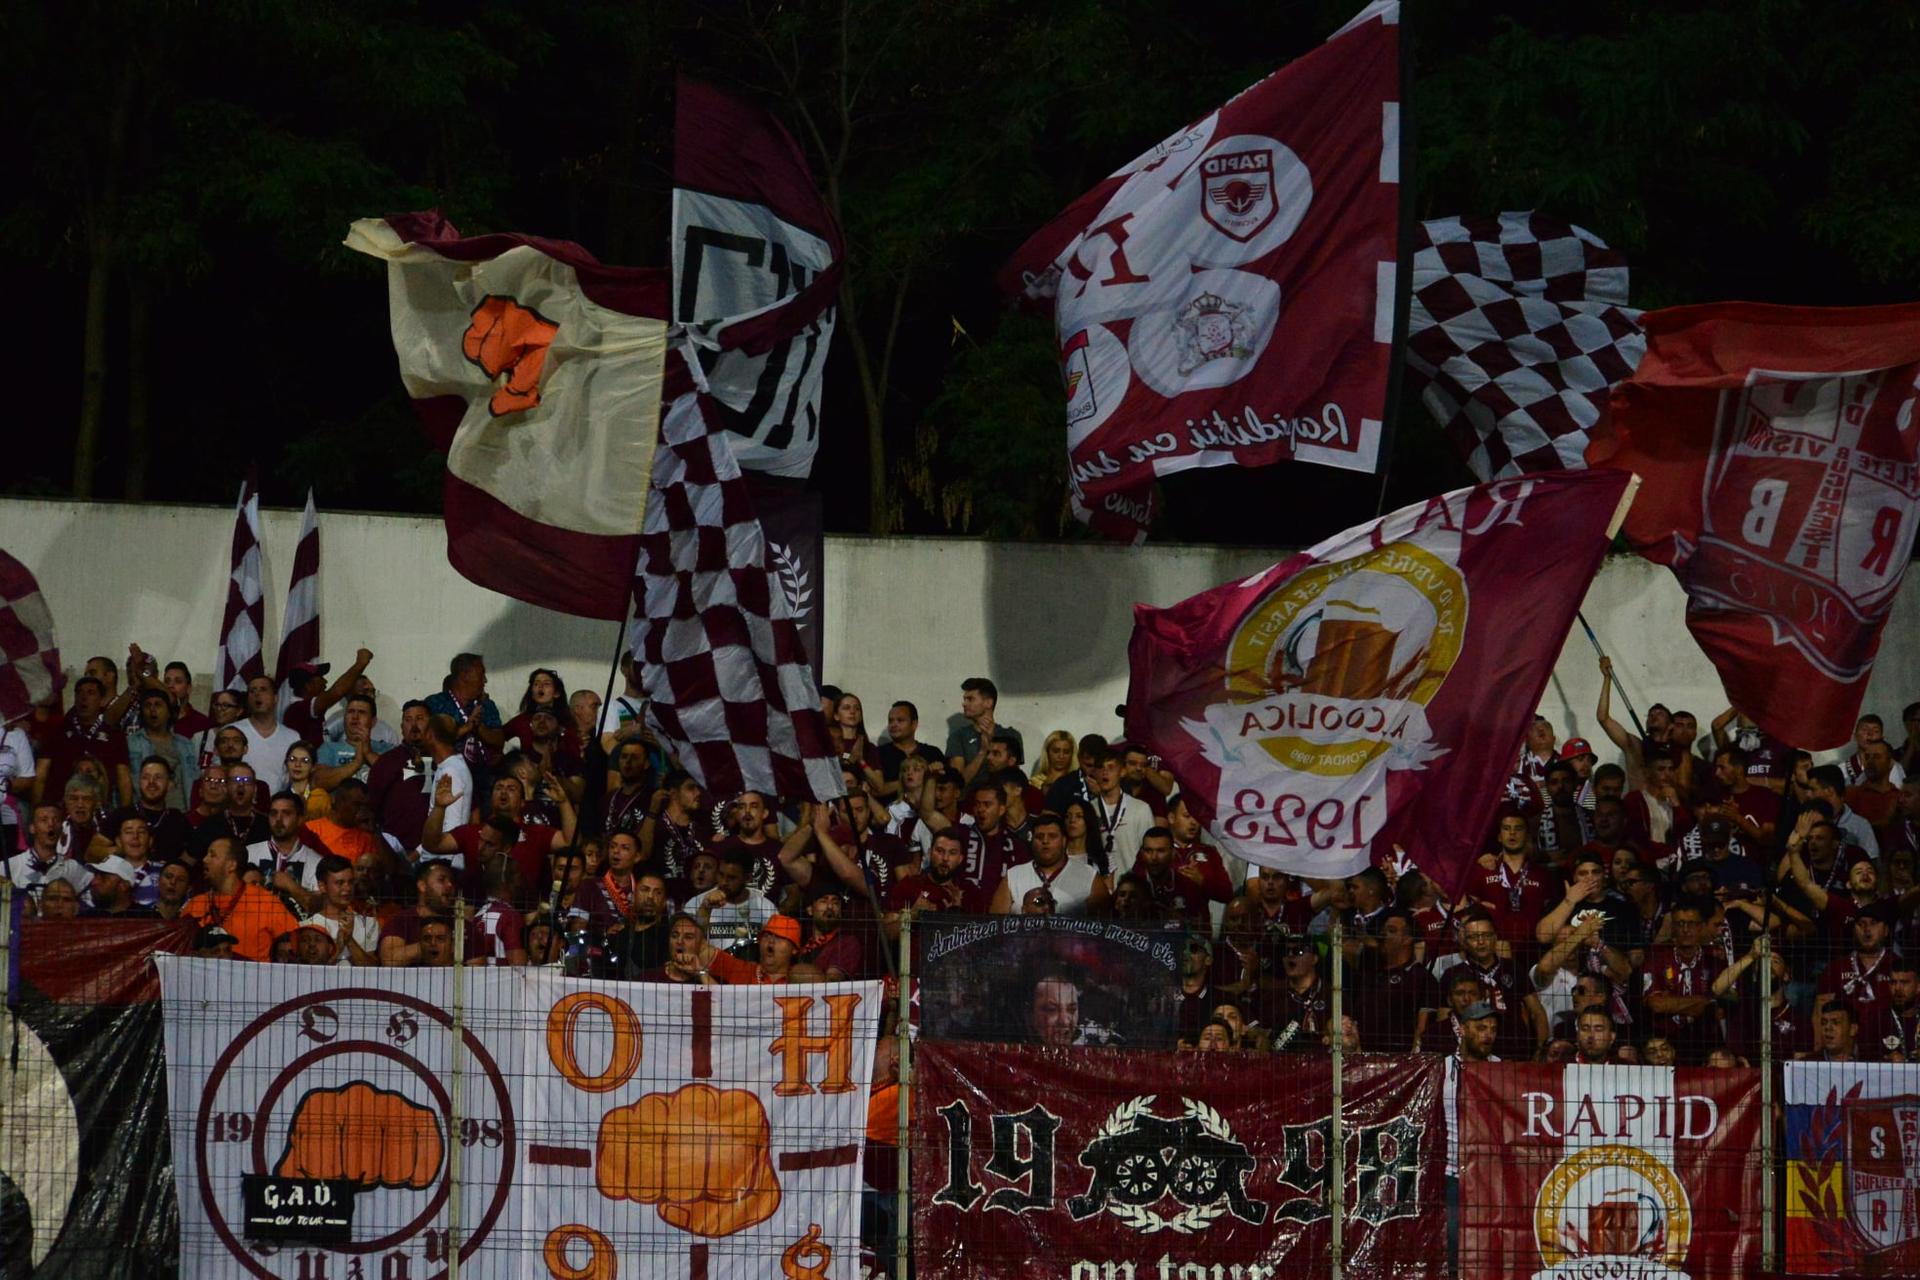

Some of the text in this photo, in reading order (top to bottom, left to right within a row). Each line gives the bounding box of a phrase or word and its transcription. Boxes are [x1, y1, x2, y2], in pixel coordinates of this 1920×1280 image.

[768, 993, 862, 1096] H
[208, 1112, 254, 1144] 19
[459, 1117, 504, 1149] 98
[1521, 1092, 1719, 1141] RAPID
[932, 1099, 1062, 1216] 19
[1870, 1125, 1886, 1160] S
[275, 1214, 294, 1226] ON
[1872, 1199, 1888, 1232] R
